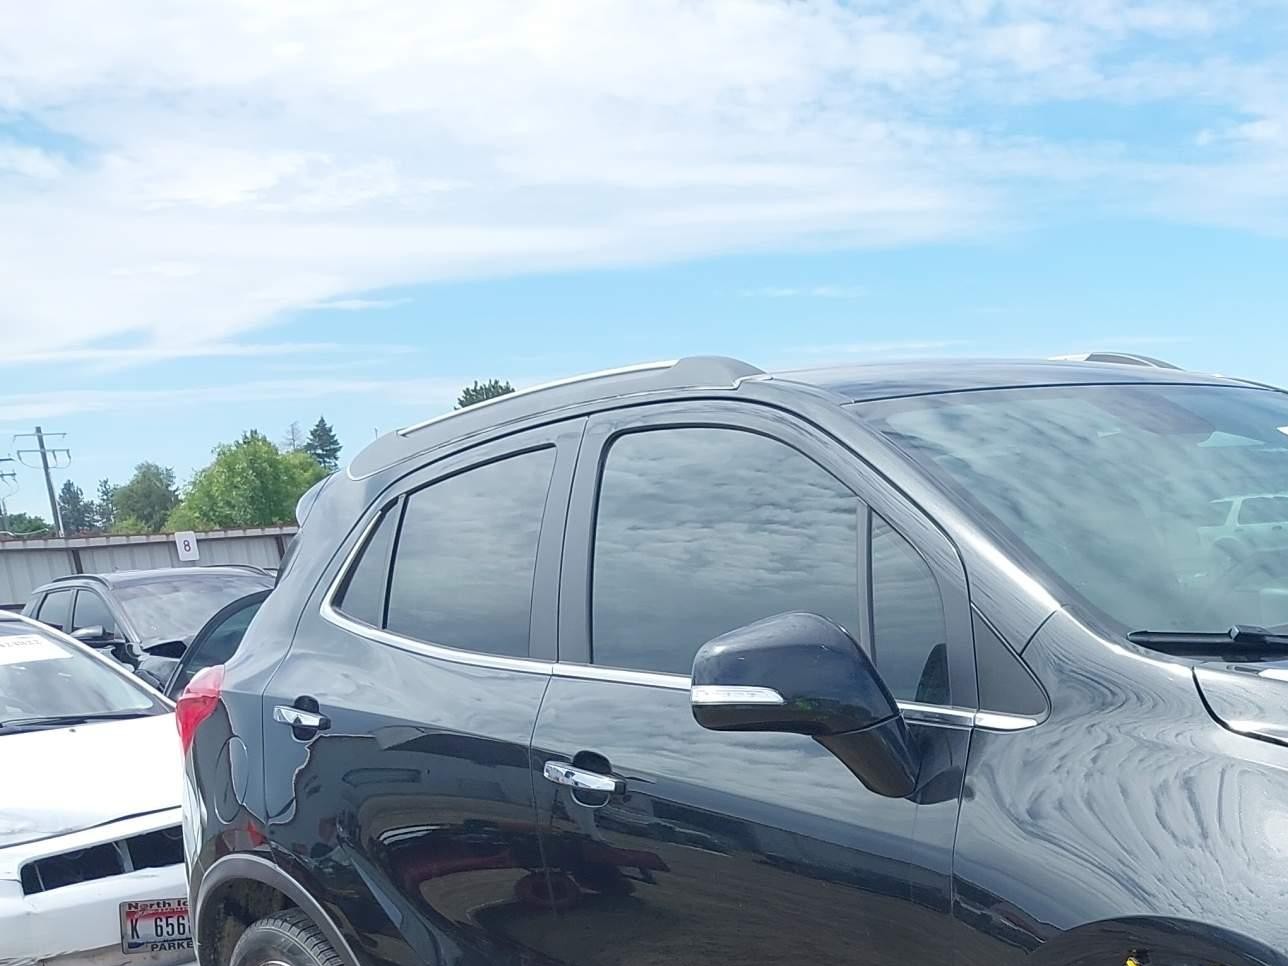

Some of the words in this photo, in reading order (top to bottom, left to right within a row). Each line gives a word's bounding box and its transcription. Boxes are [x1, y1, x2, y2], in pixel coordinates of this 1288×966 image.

[183, 539, 192, 552] 8
[128, 901, 172, 911] North
[130, 917, 140, 940] K
[154, 914, 191, 938] 656
